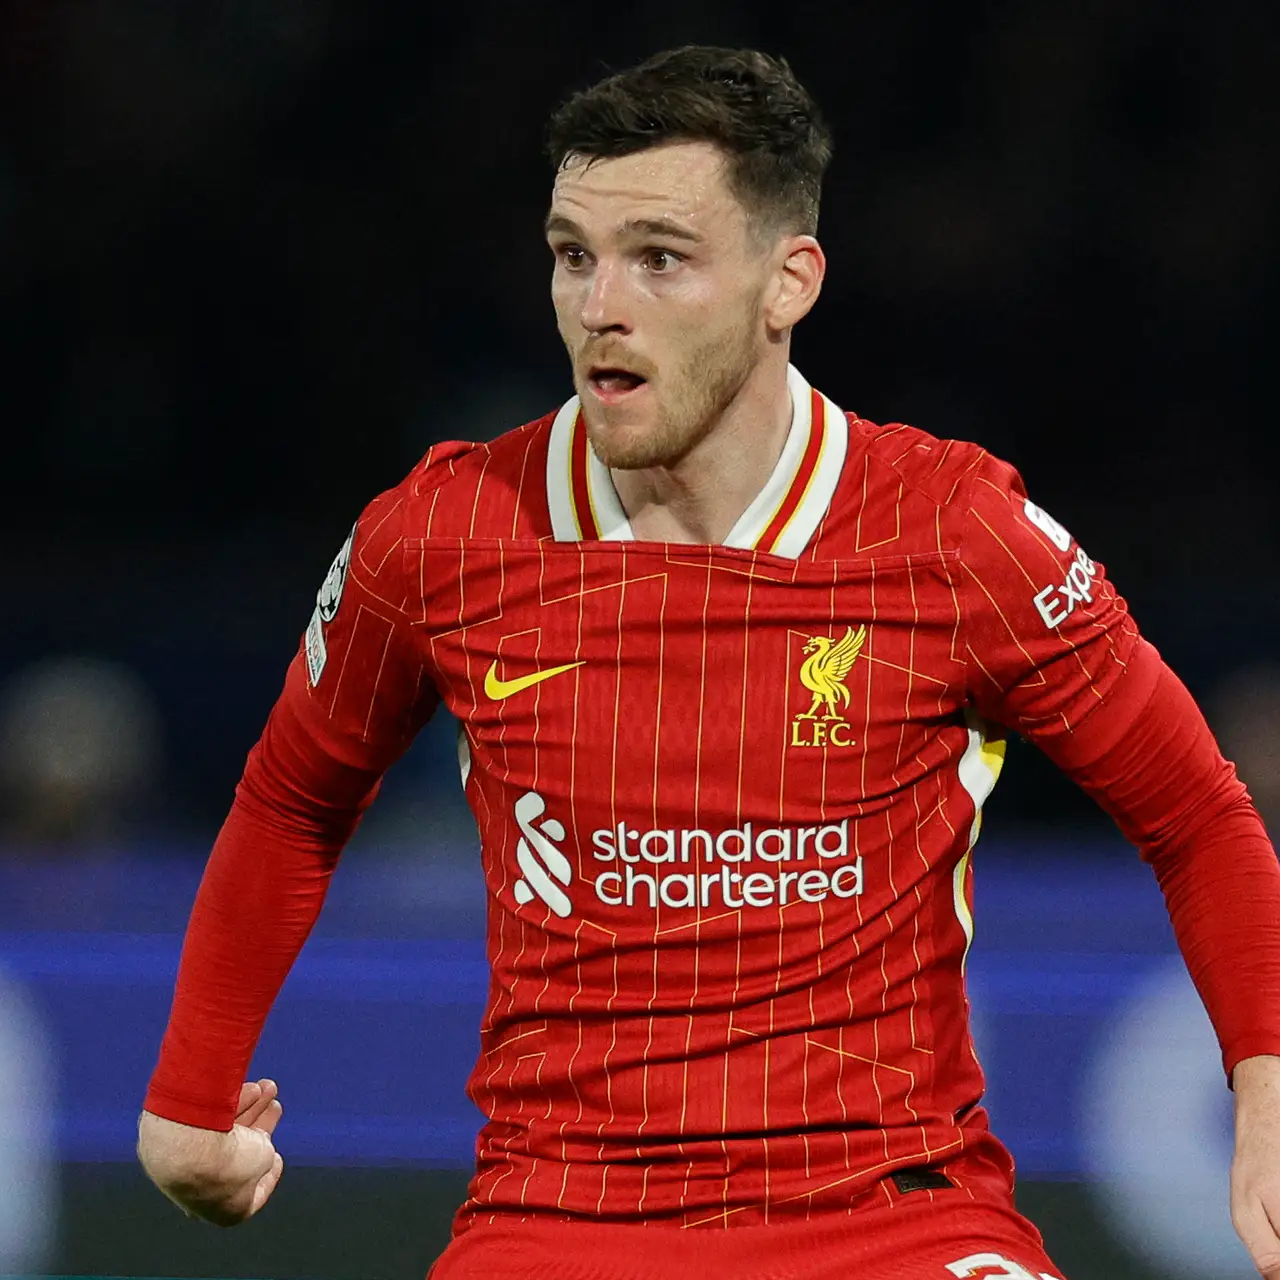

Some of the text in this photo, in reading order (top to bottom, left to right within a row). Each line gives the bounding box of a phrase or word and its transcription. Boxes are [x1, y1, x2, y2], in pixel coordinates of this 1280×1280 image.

[791, 721, 856, 747] L.F.C.
[592, 819, 848, 863] standard
[595, 856, 863, 908] chartered
